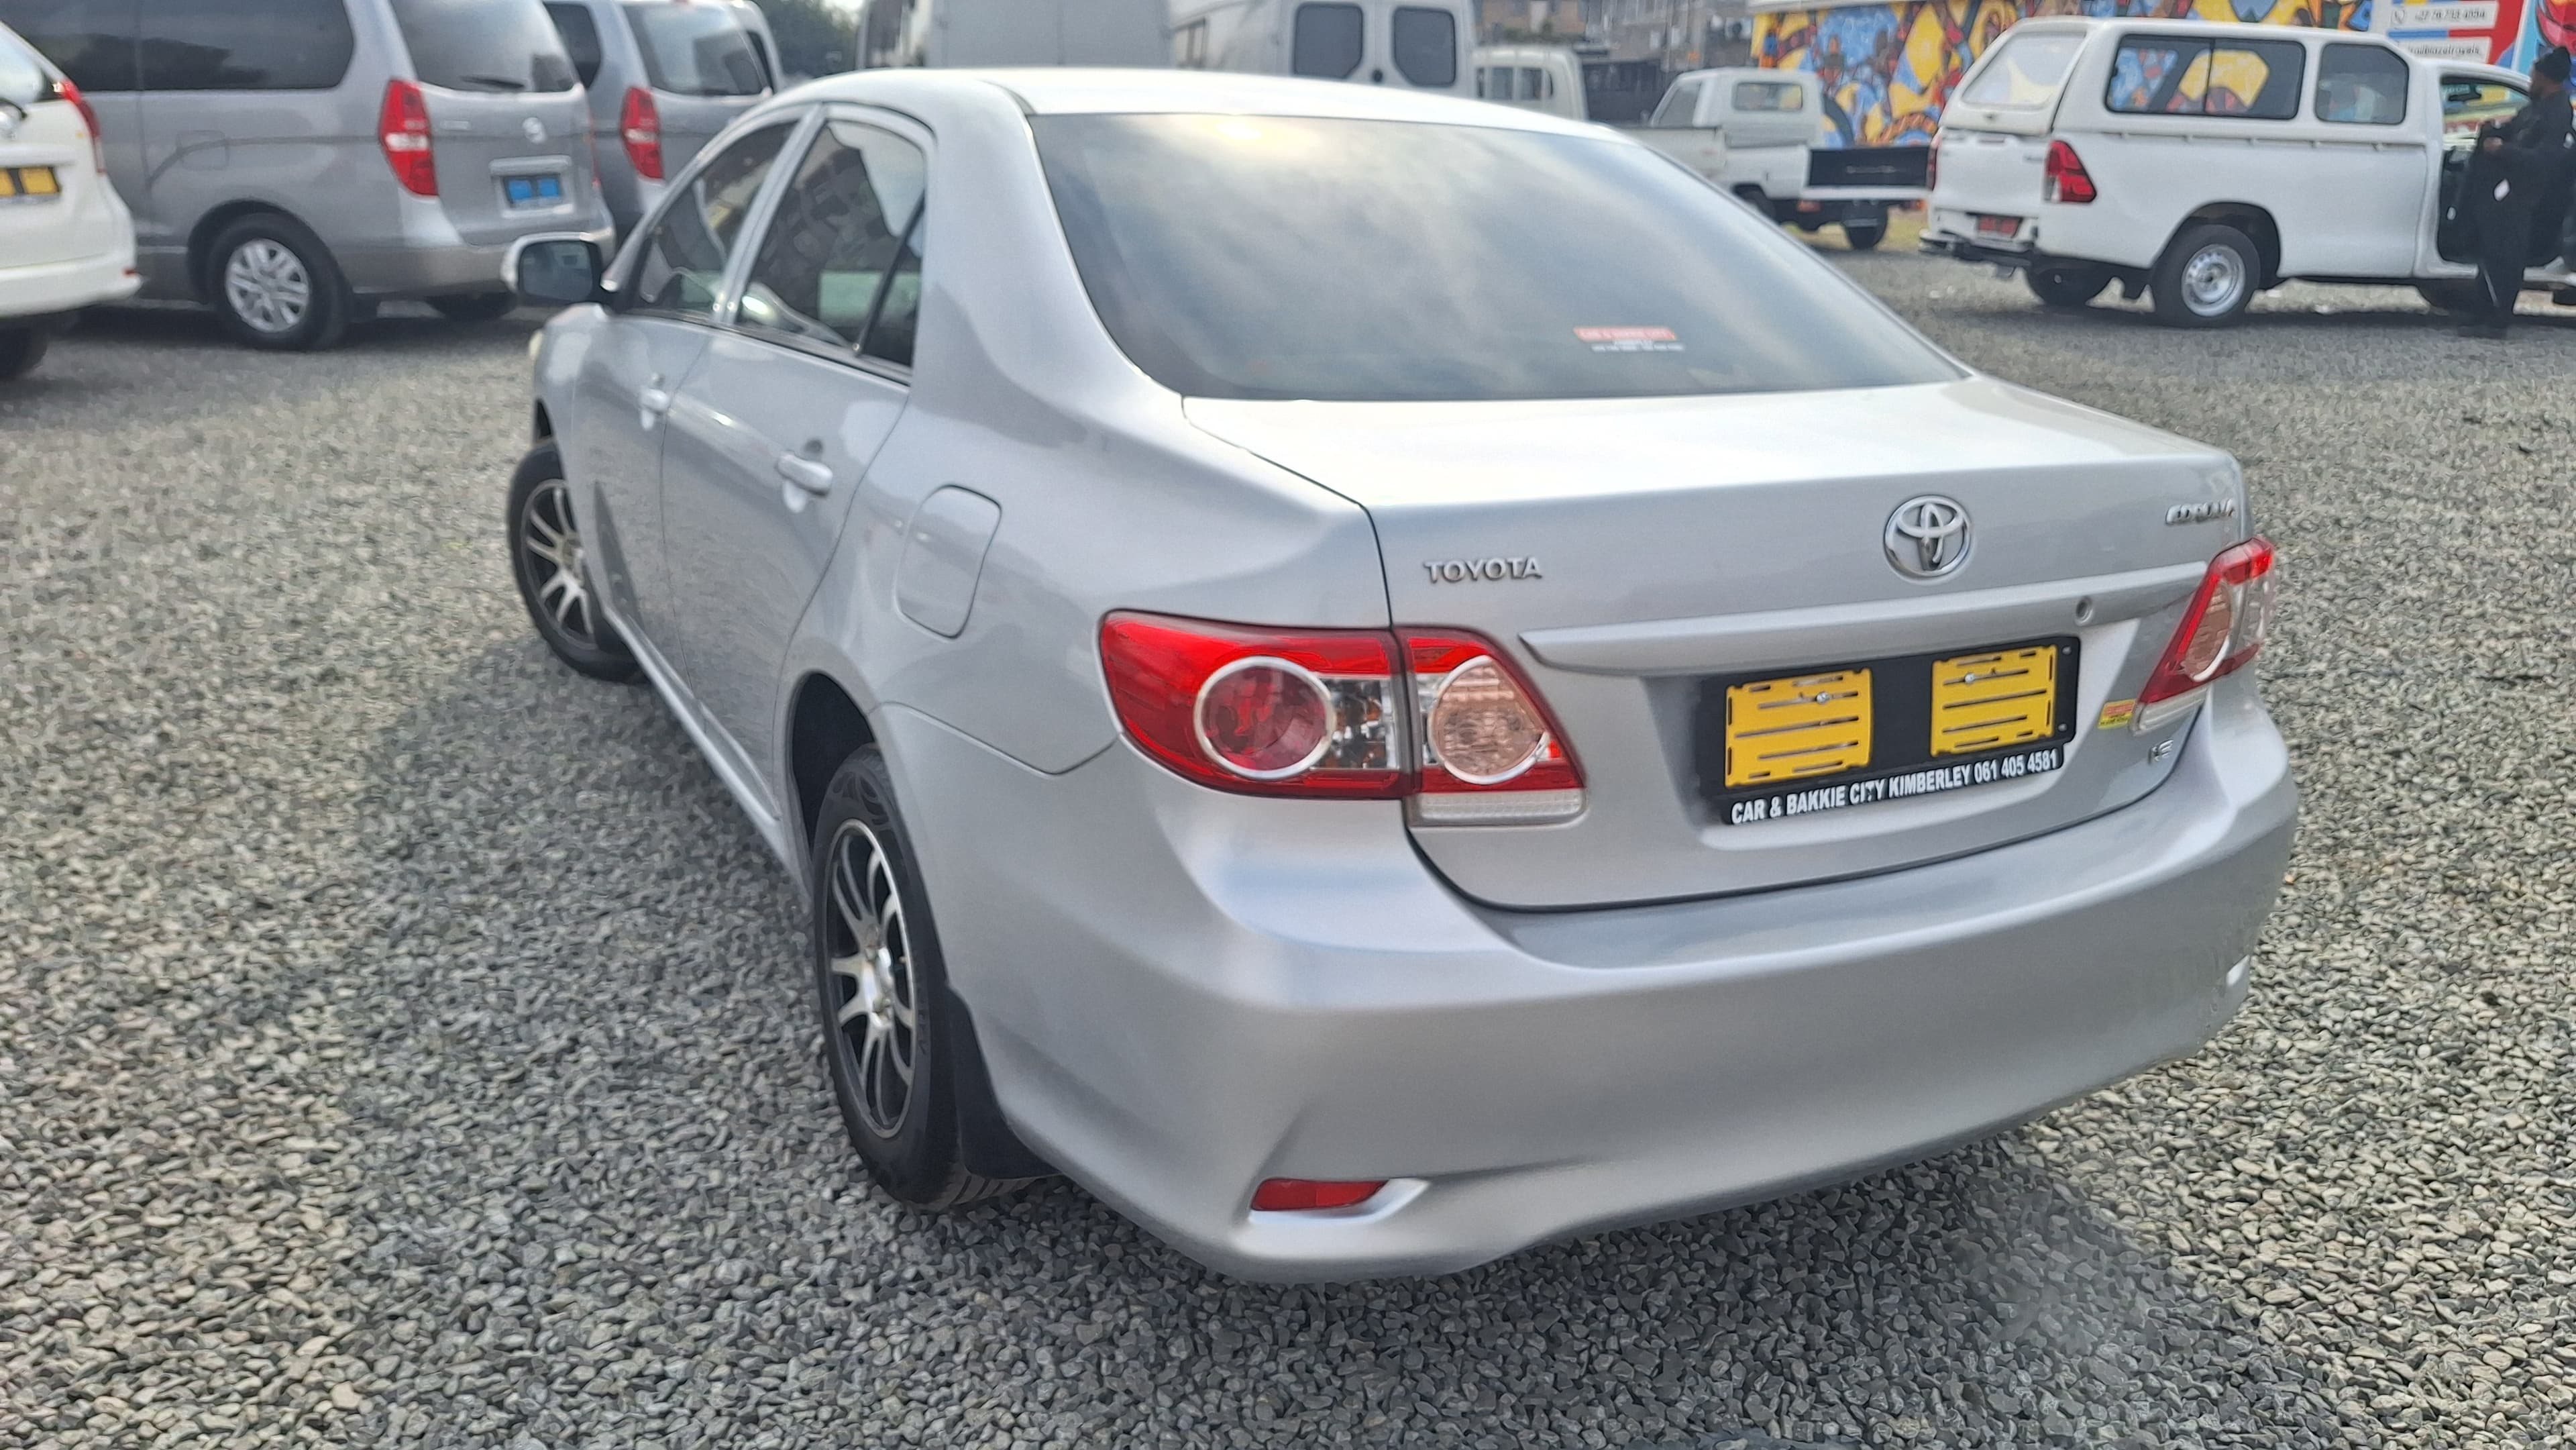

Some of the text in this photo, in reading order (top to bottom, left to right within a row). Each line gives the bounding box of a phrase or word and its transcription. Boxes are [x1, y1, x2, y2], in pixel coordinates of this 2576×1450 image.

[1423, 556, 1542, 584] TOYOTA
[1731, 748, 2057, 825] CAR & BAKKIE CITY KIMBERLEY 061 405 4581
